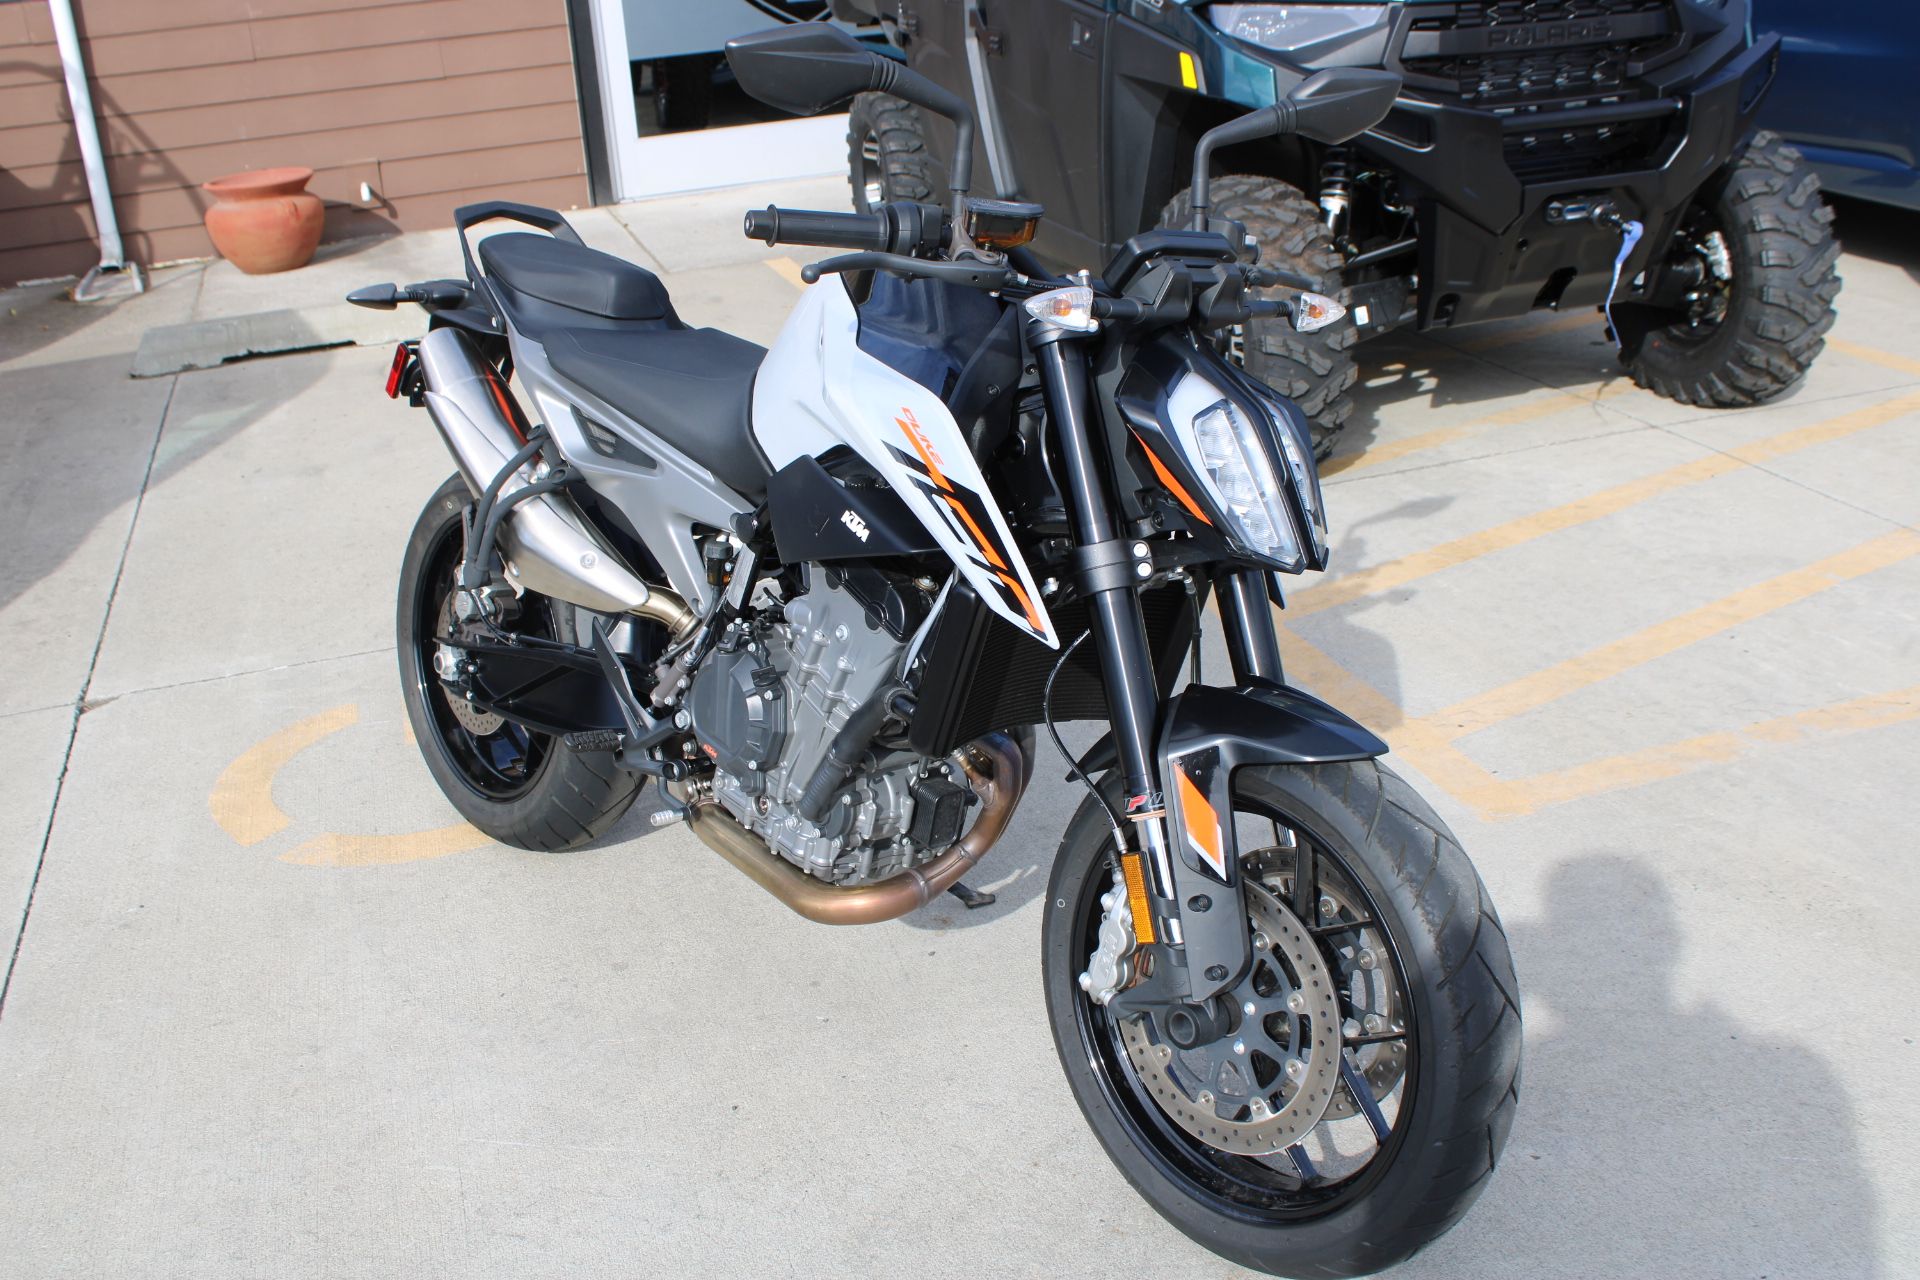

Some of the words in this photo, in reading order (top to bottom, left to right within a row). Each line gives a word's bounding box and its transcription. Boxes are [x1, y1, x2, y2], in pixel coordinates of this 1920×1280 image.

[1487, 19, 1613, 47] POLARIS
[901, 407, 945, 466] DUKE
[840, 510, 870, 543] KTM
